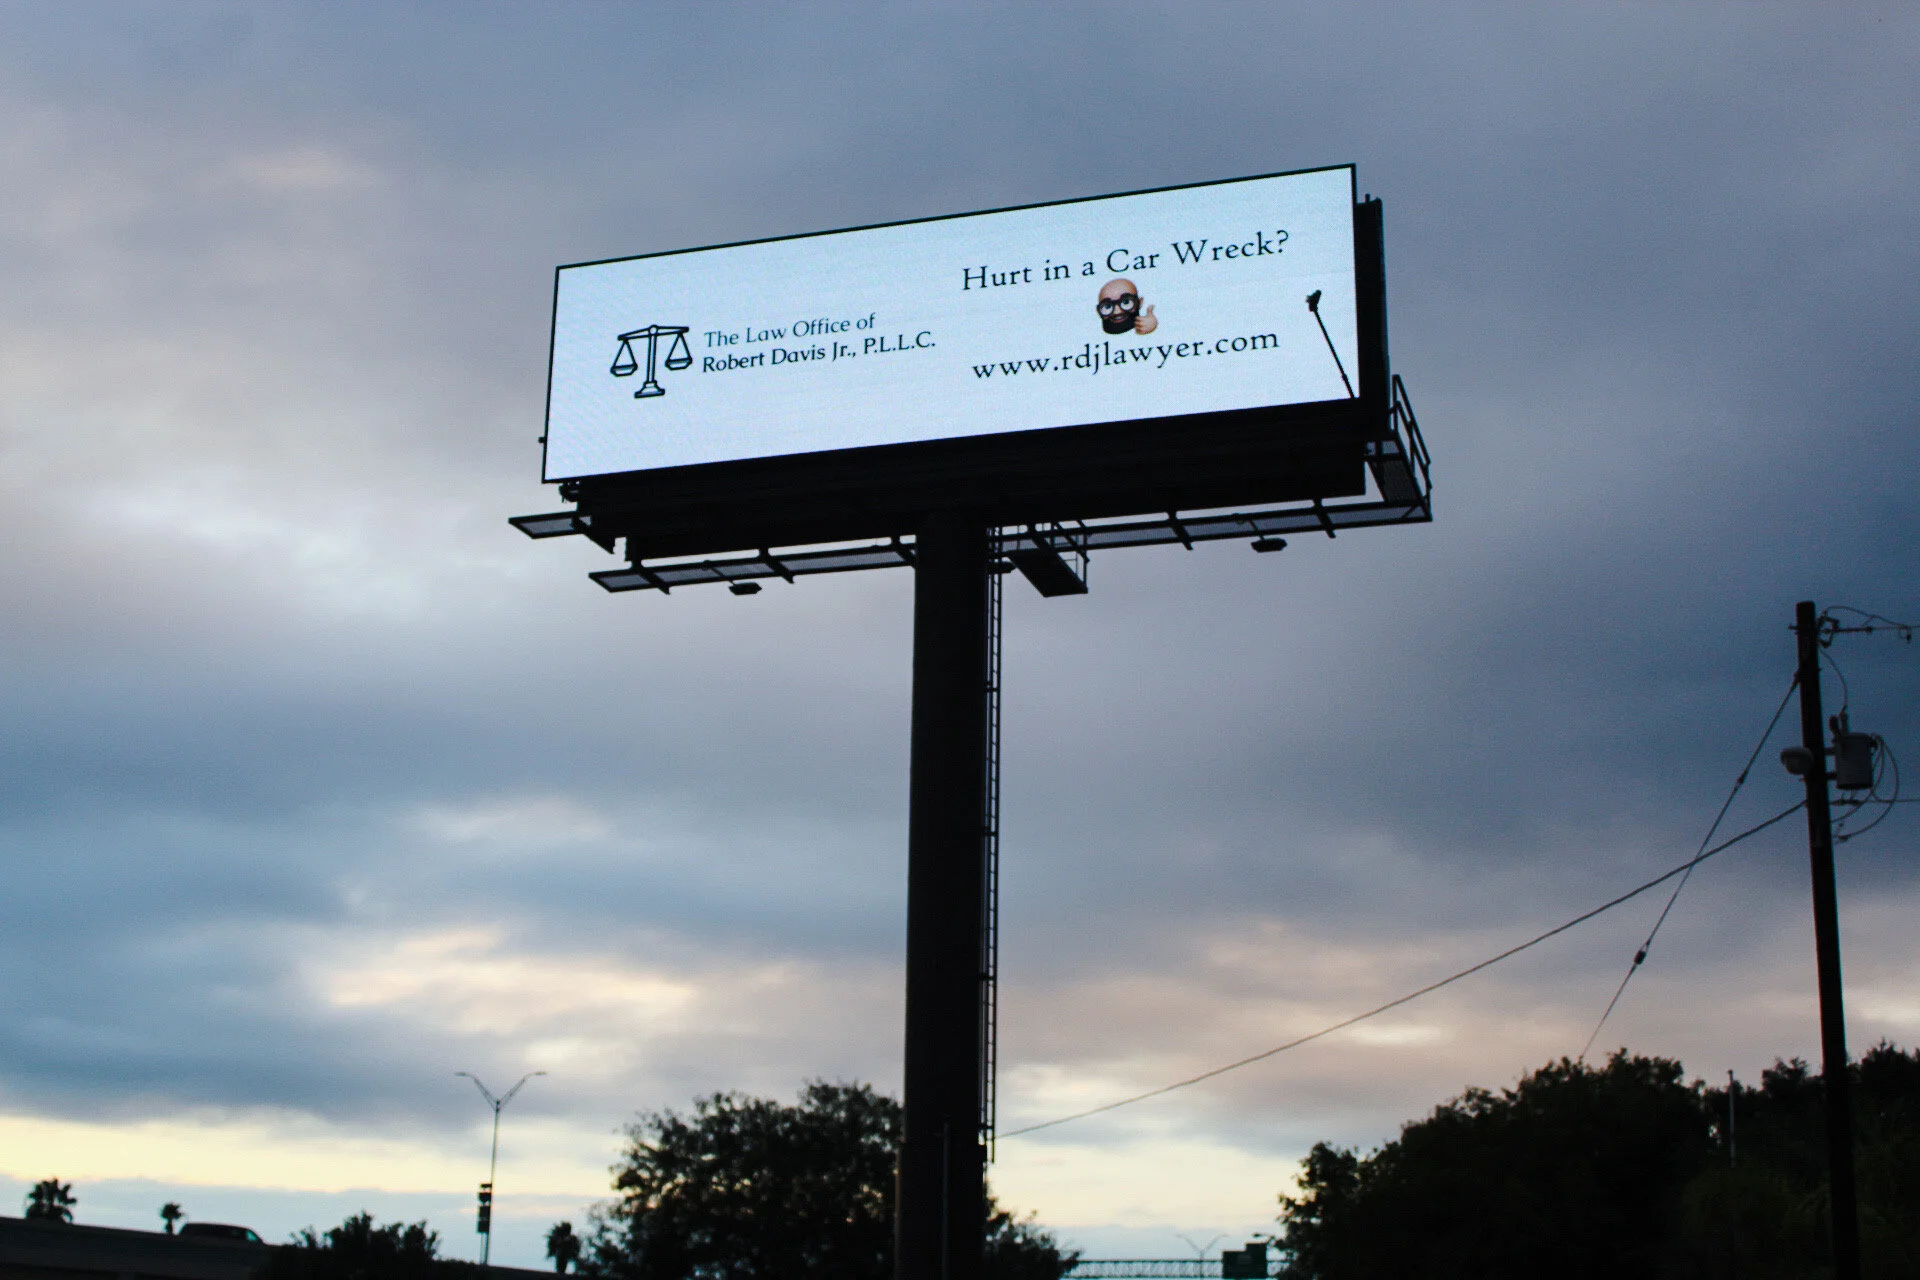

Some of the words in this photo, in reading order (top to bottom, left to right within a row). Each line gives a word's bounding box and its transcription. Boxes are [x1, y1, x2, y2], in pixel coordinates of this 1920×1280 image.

[963, 265, 1032, 291] Hurt
[1044, 259, 1071, 281] in
[1081, 261, 1095, 277] a
[1106, 248, 1160, 273] Car
[1170, 229, 1289, 265] Wreck?
[702, 352, 765, 373] Robert
[771, 344, 826, 365] Davis
[832, 341, 857, 362] Jr.,
[863, 330, 936, 355] P.L.L.C.
[704, 330, 740, 348] The
[746, 327, 787, 344] Law
[792, 318, 851, 338] Office
[856, 312, 876, 330] of
[972, 333, 1279, 379] www.rdjlawyer.com
